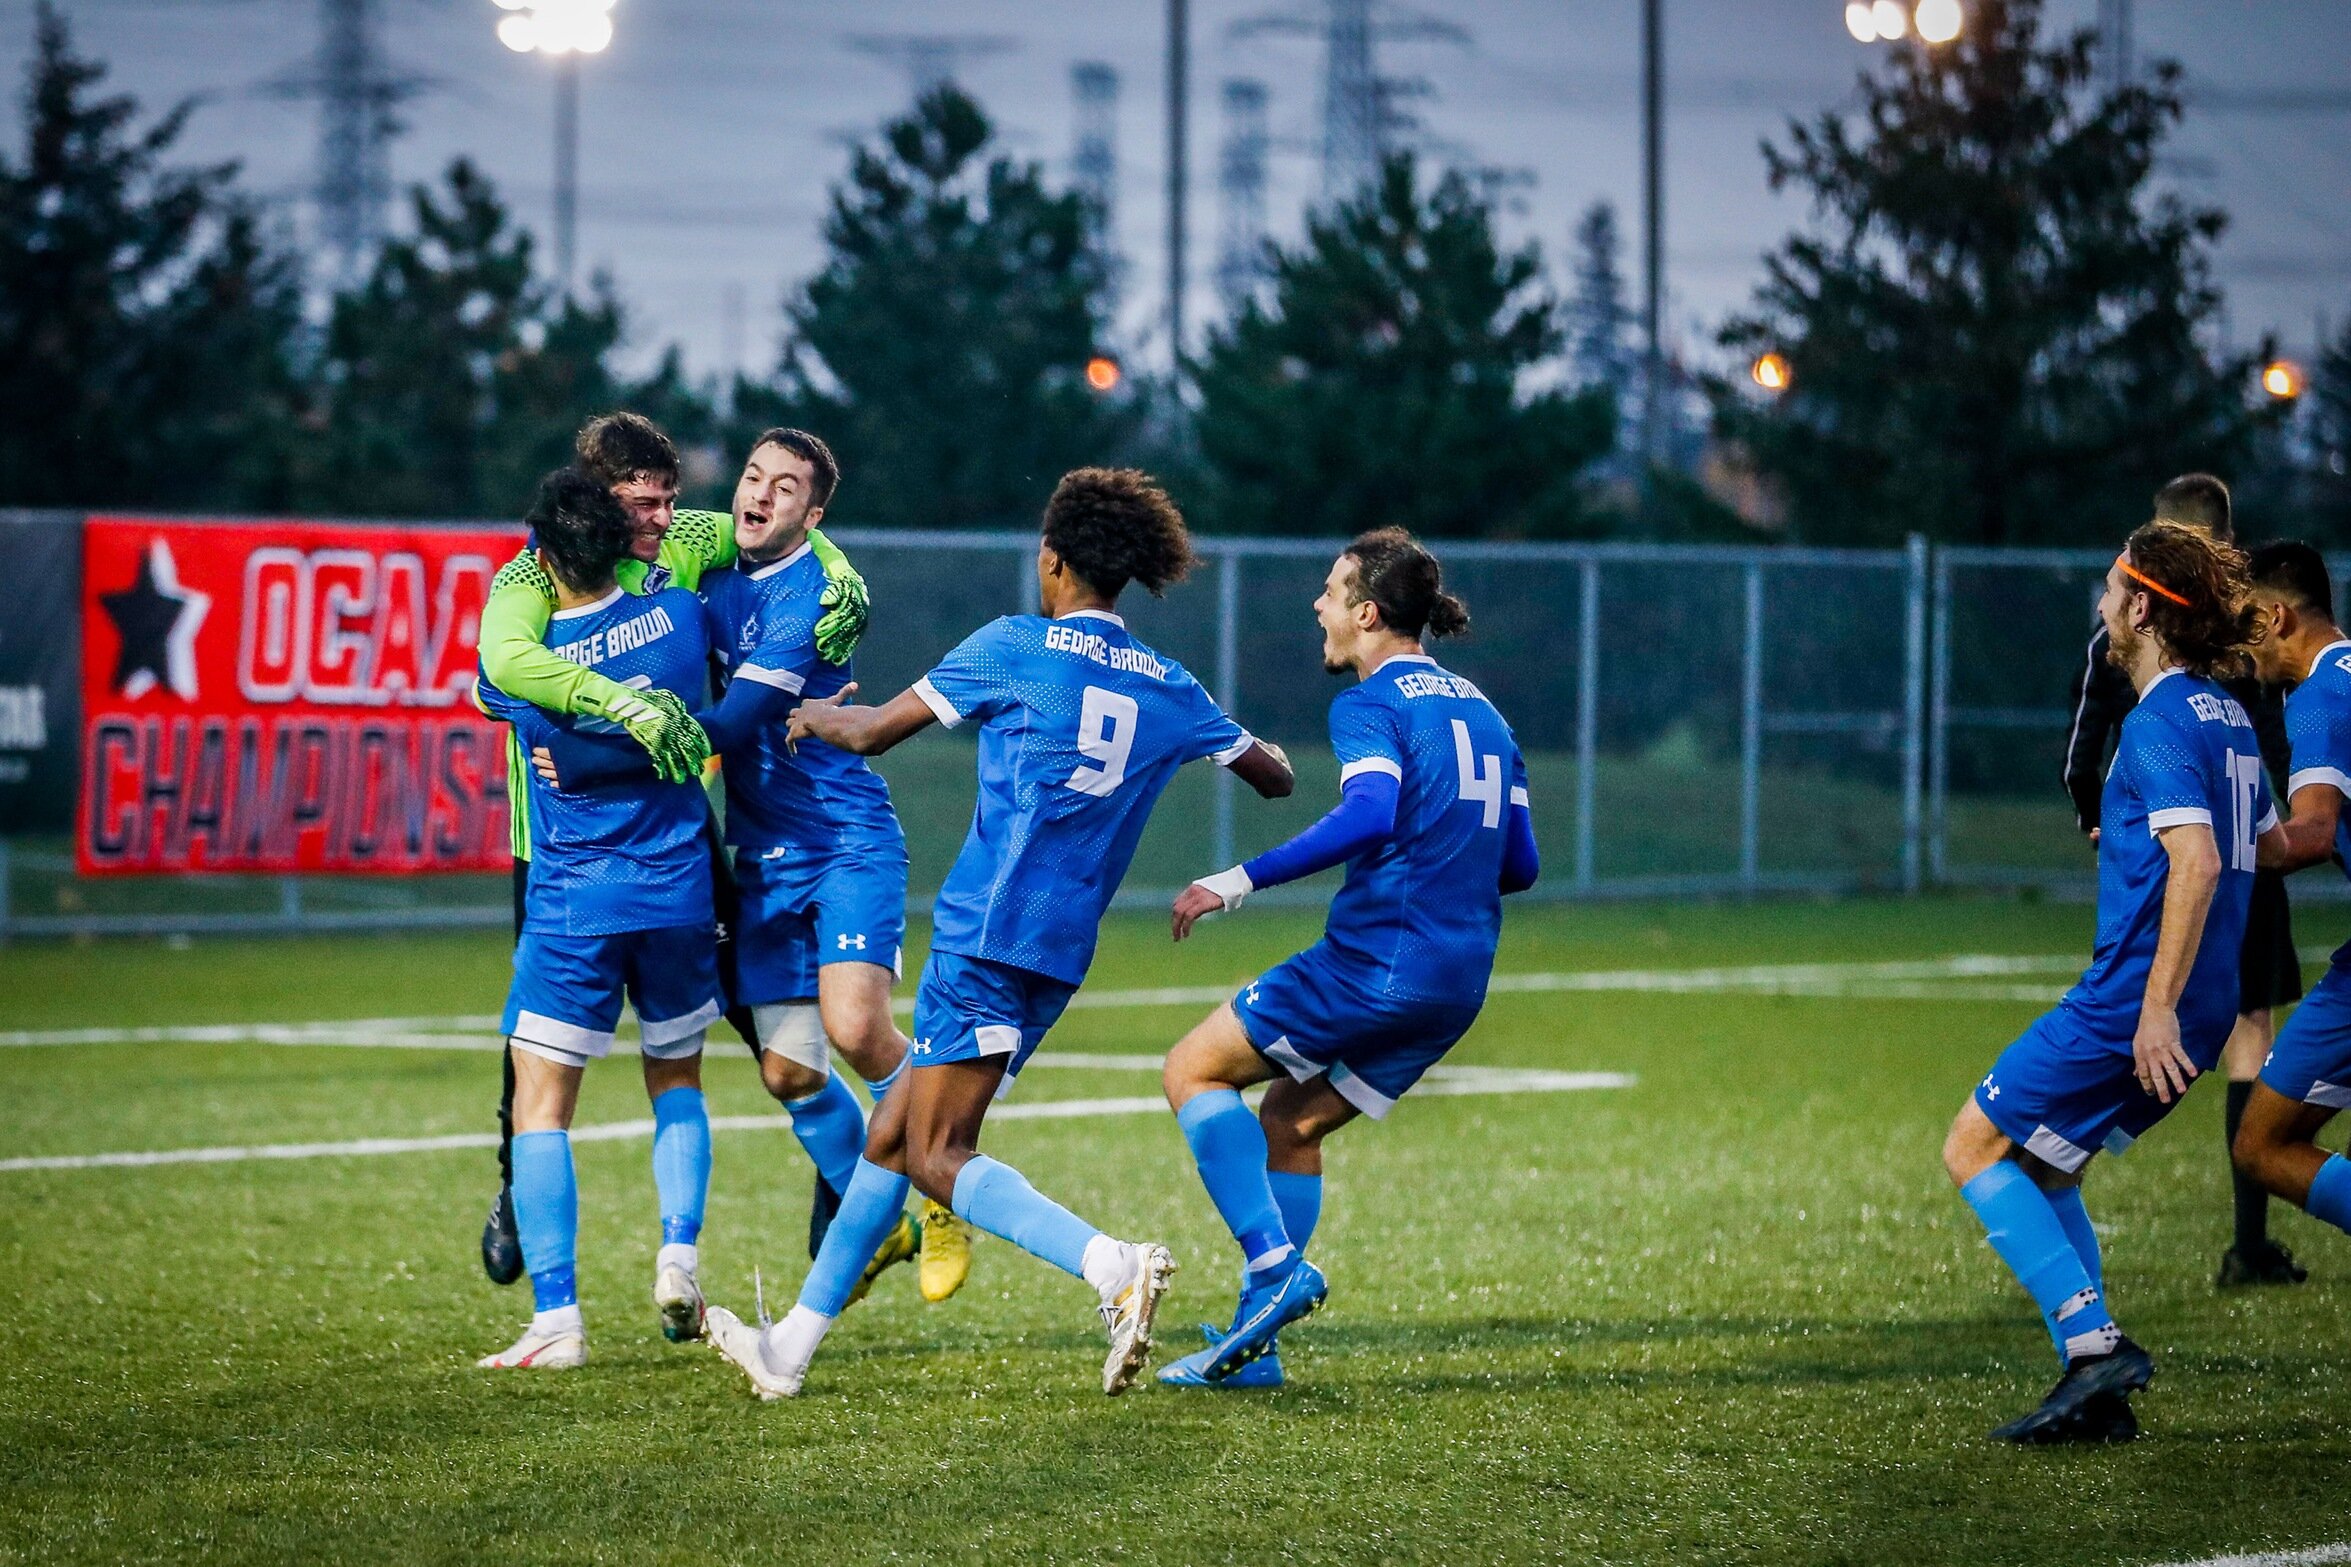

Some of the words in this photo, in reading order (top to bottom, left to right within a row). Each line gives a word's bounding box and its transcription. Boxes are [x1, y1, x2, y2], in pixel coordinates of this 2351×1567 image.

[237, 546, 493, 708] OCAA
[553, 633, 604, 667] RGE
[607, 606, 675, 659] BROWN
[1045, 625, 1108, 666] GEORGE
[1109, 645, 1166, 681] BROWN
[1394, 672, 1457, 698] GEORGE
[90, 714, 512, 868] CHAMPIONSH
[1064, 685, 1139, 798] 9
[1450, 718, 1502, 829] 4
[2225, 747, 2260, 873] 10
